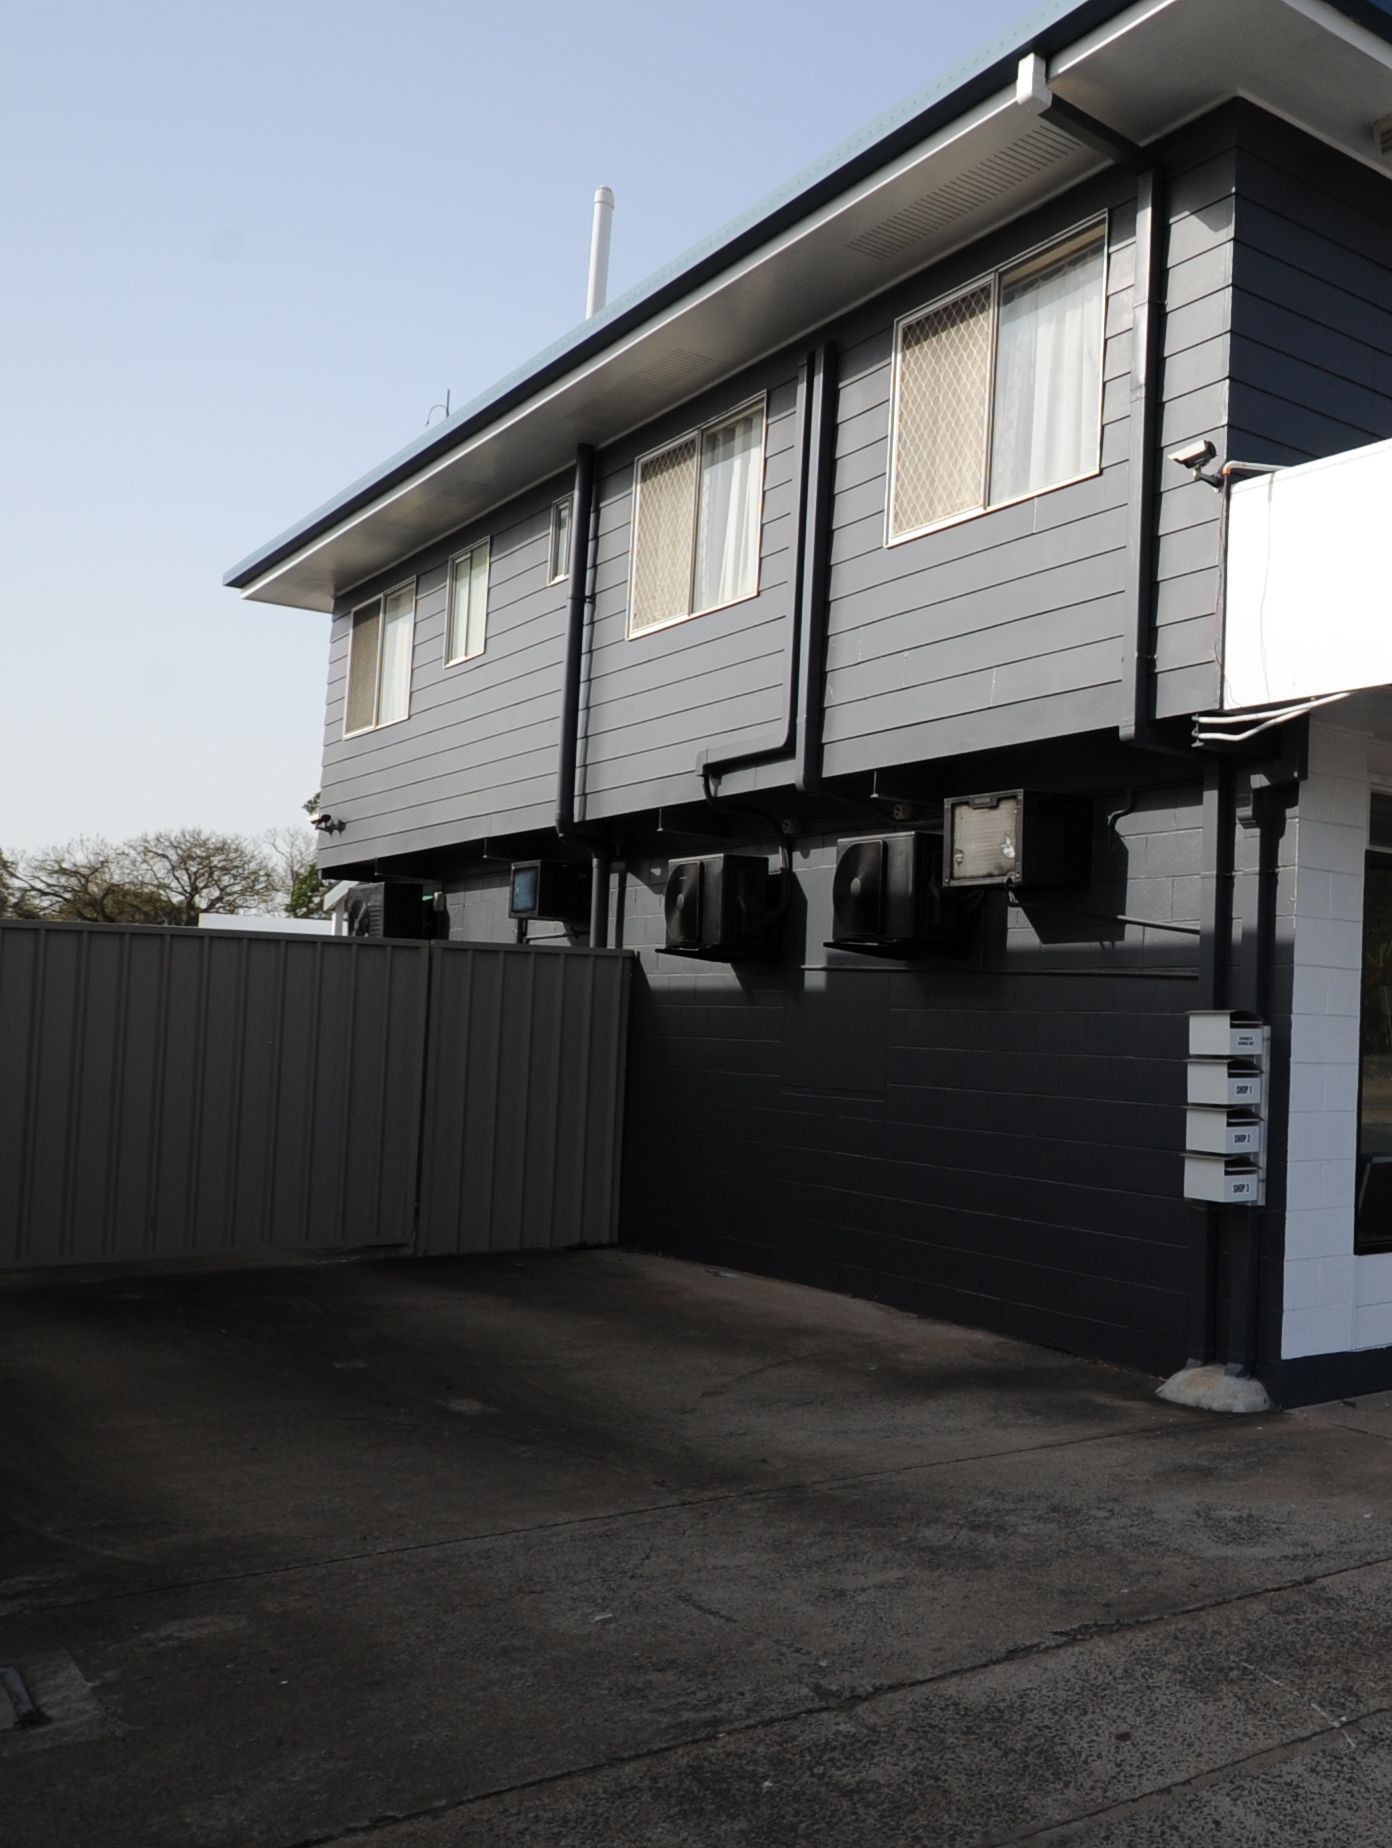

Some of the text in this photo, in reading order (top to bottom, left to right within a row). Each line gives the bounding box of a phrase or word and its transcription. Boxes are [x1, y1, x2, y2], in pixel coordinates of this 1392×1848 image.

[1236, 1085, 1248, 1094] SHOP
[1234, 1134, 1246, 1143] SHOP
[1233, 1184, 1245, 1193] SHOP
